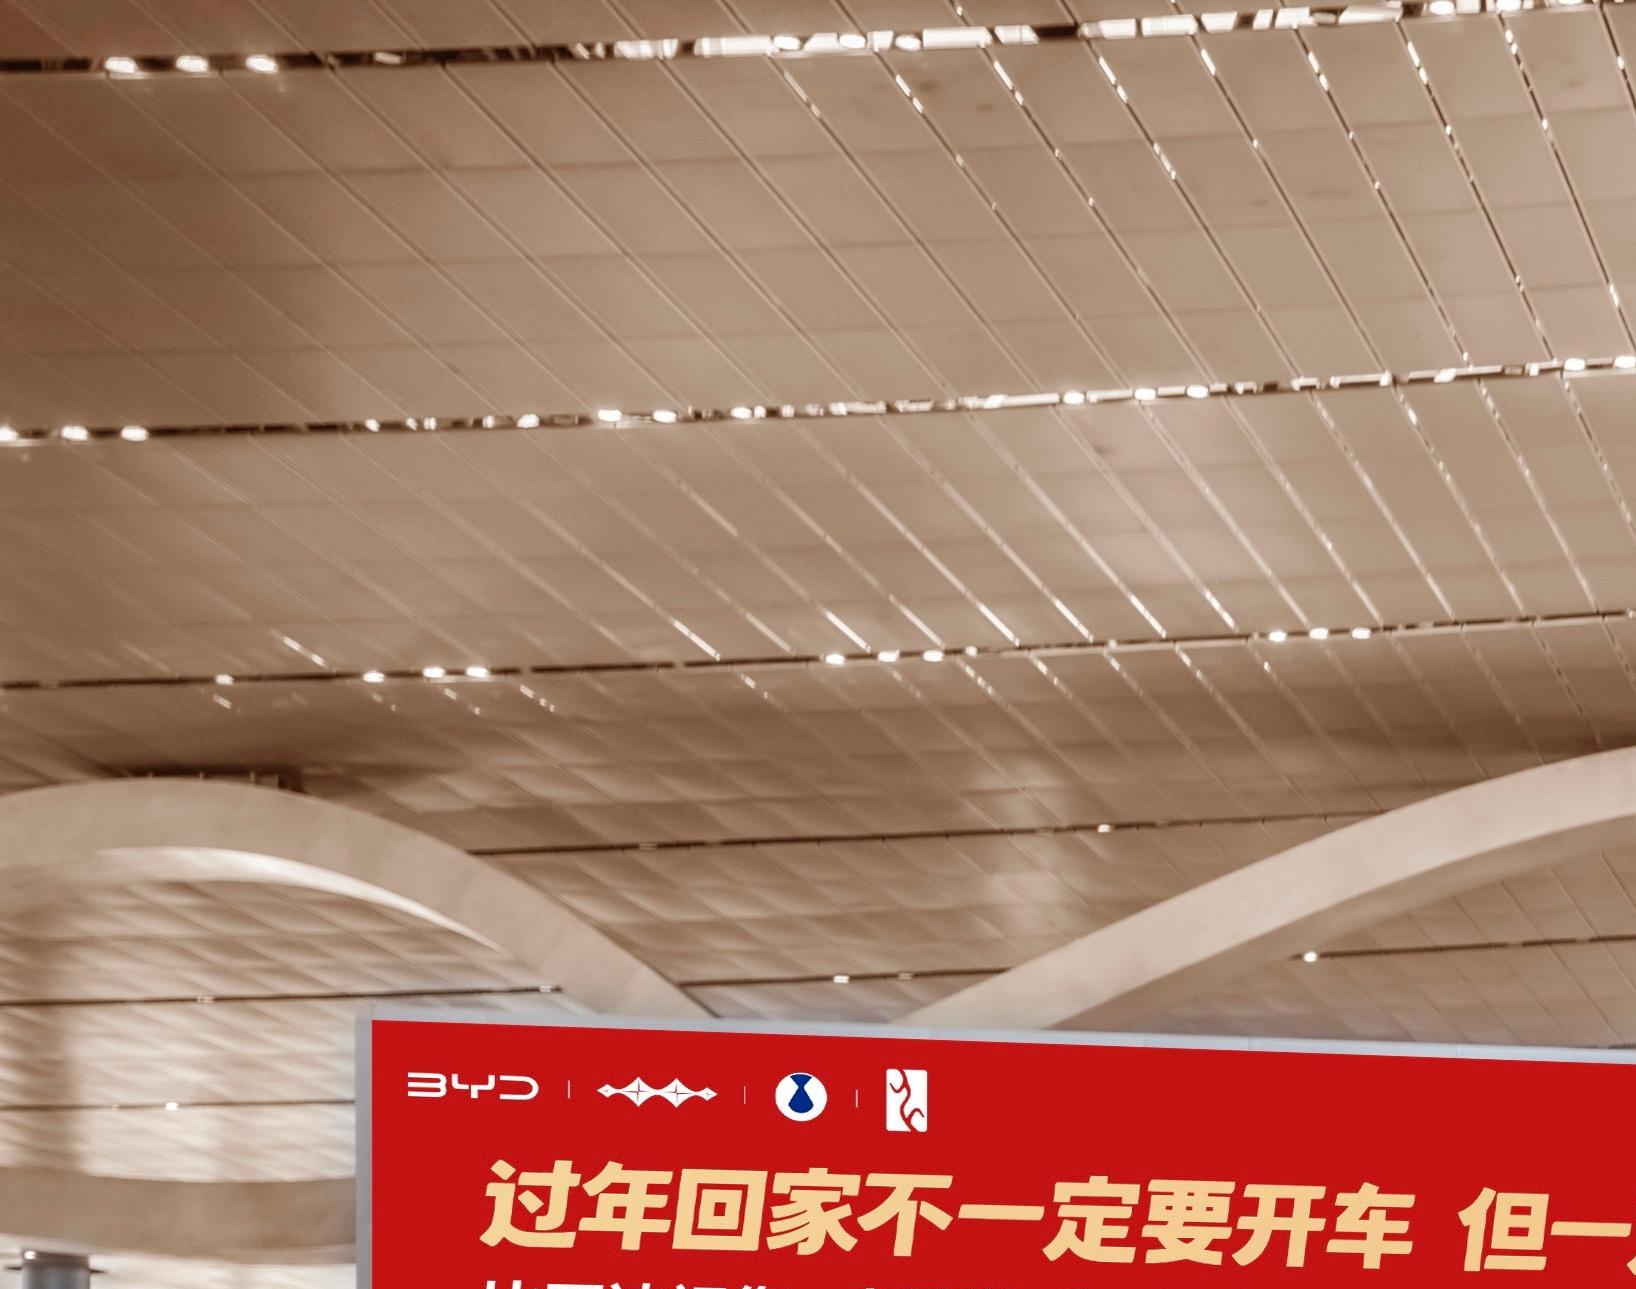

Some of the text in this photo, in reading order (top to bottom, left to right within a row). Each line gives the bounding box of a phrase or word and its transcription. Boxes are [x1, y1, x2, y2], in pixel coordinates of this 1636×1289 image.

[407, 1072, 539, 1100] BYD
[478, 1158, 1414, 1273] 过年回家不一定要开车
